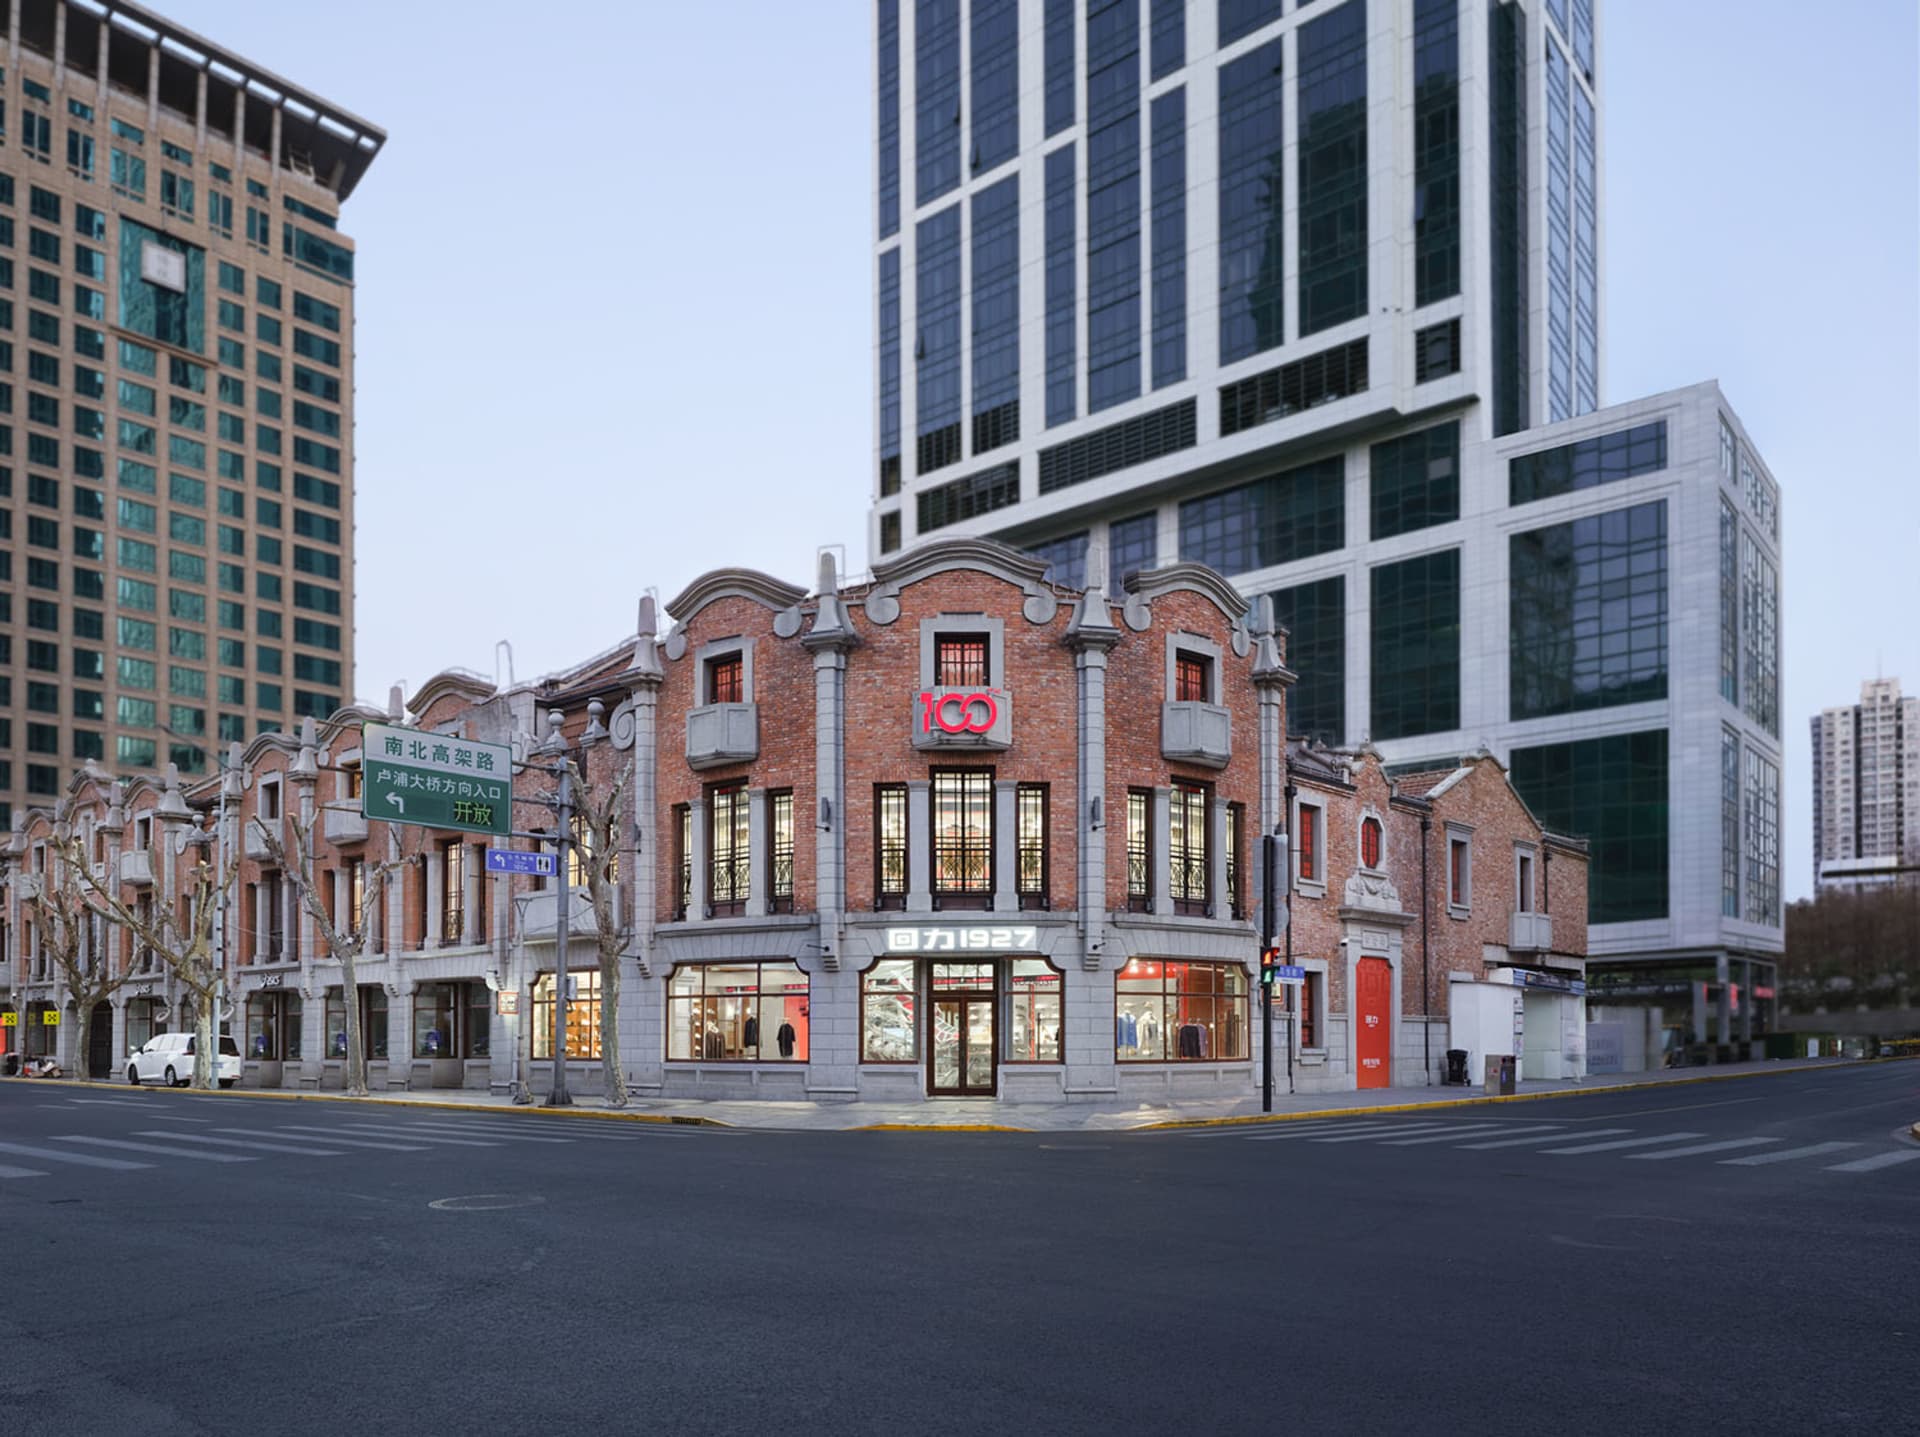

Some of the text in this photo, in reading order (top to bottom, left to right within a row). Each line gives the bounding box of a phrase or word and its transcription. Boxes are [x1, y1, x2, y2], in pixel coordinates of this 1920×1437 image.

[919, 692, 998, 734] 100
[384, 736, 494, 771] 南北高架路
[376, 769, 501, 799] 卢浦大桥方向入口
[453, 800, 492, 826] 开放
